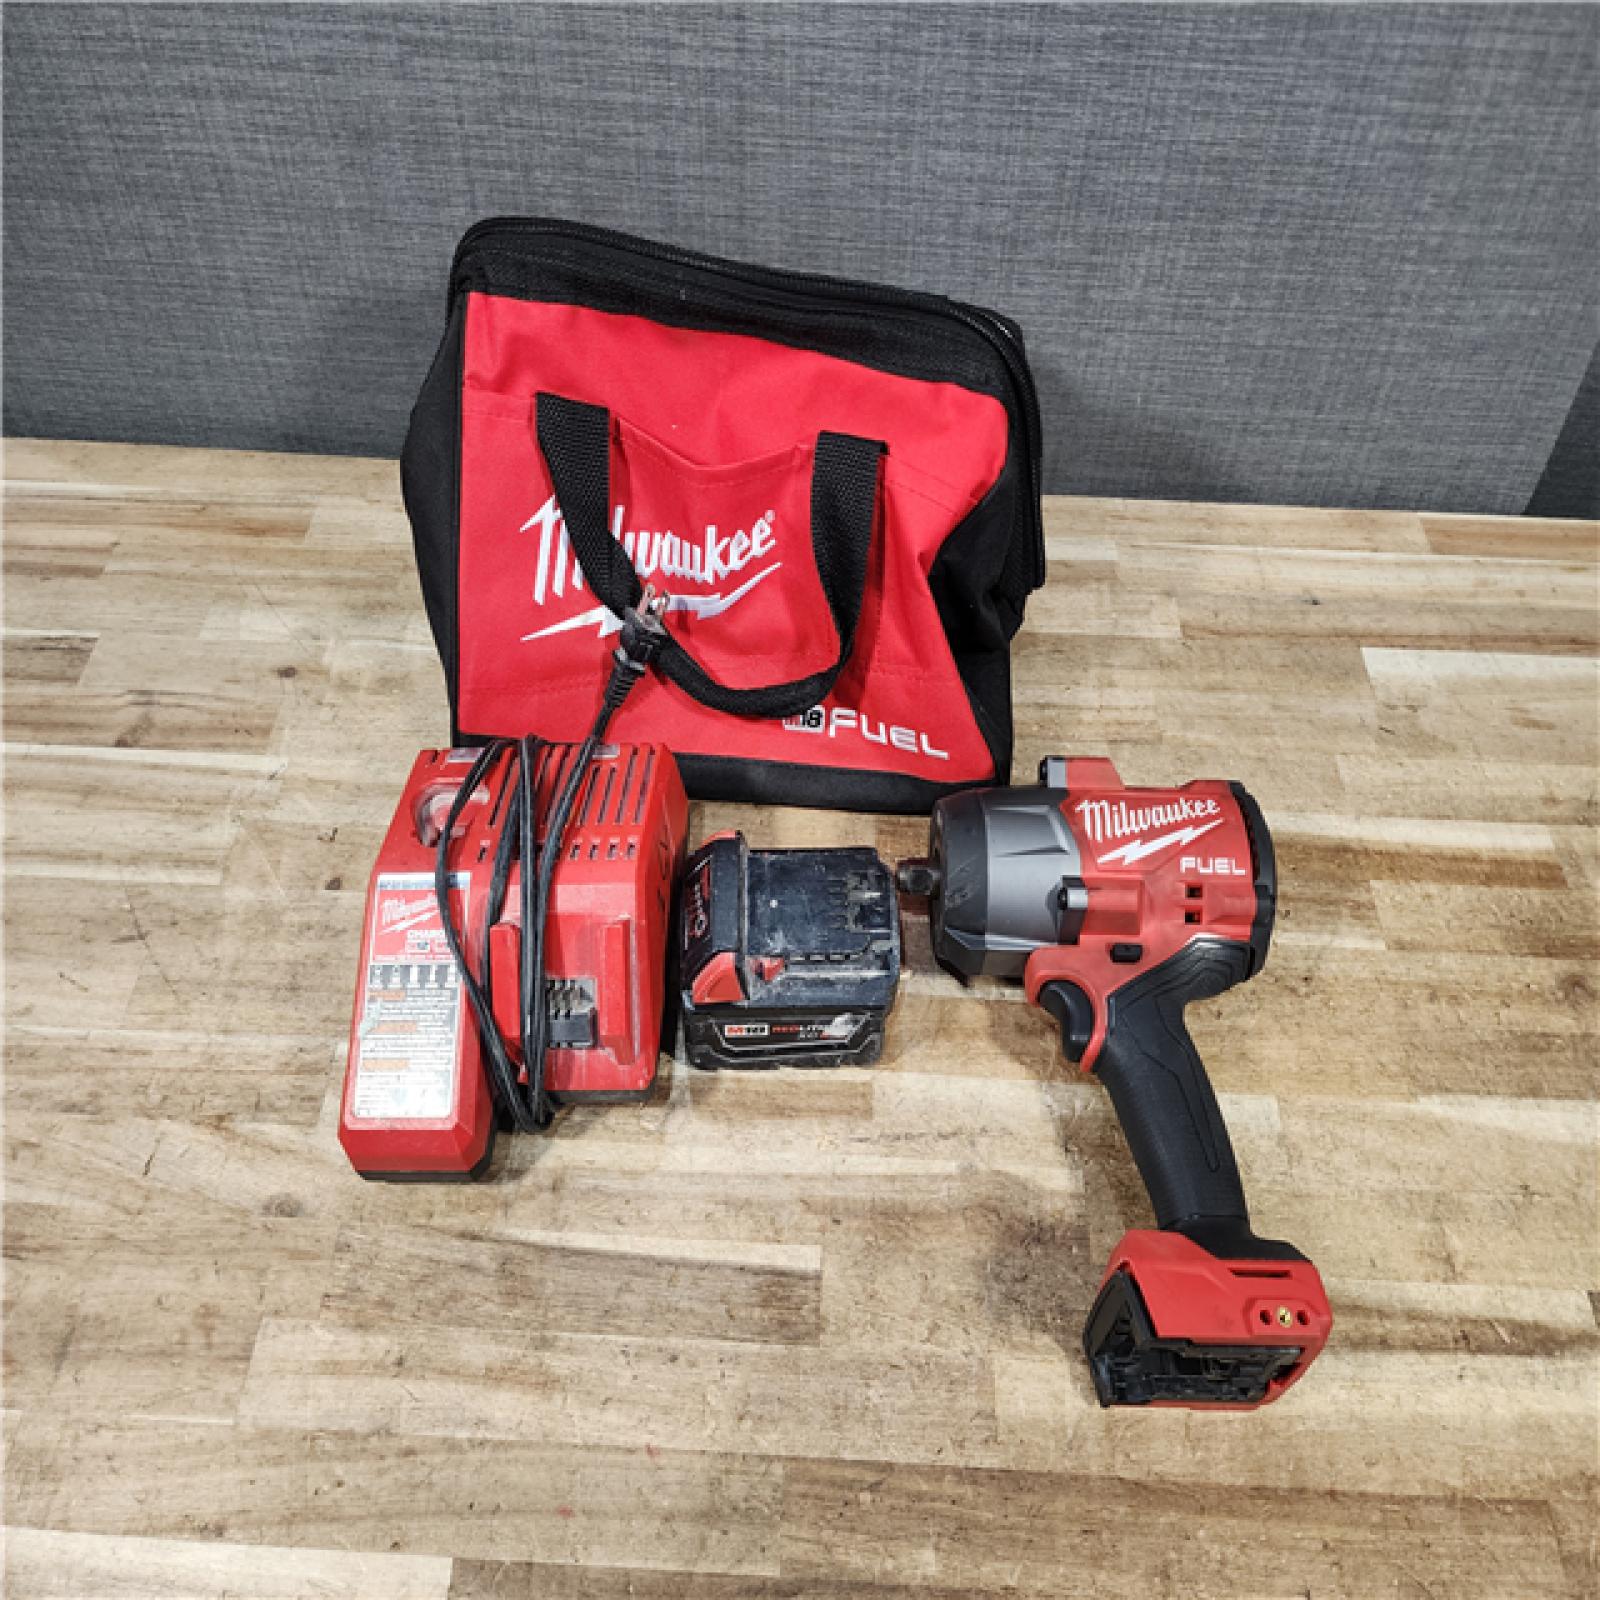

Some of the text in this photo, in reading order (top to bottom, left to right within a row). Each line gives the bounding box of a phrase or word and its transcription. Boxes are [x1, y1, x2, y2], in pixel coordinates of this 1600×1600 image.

[828, 706, 950, 761] FUEL
[1075, 797, 1221, 844] Milwaukee
[1179, 857, 1247, 876] FUEL
